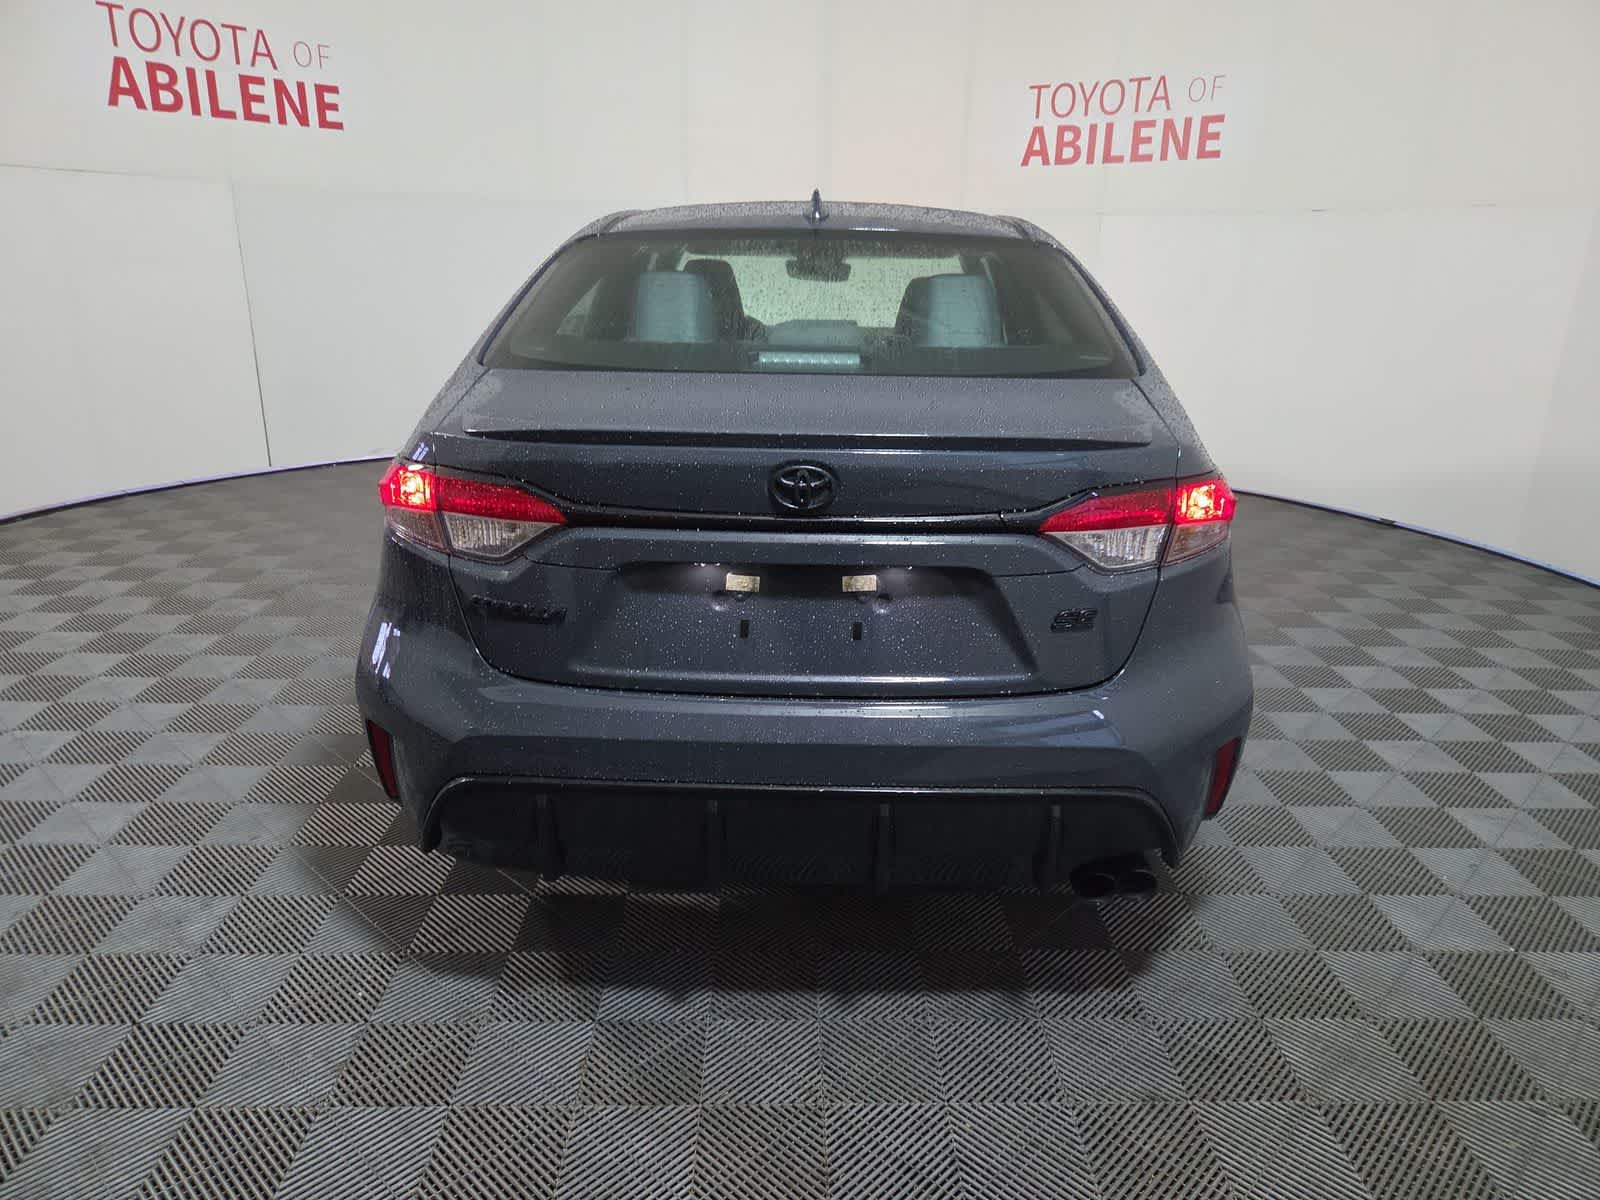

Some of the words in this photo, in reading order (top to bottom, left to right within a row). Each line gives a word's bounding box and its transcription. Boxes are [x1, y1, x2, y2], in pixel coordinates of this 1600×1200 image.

[95, 0, 278, 70] TOYOTA
[293, 41, 331, 69] OF
[107, 55, 344, 130] ABILENE
[1028, 75, 1171, 119] TOYOTA
[1188, 74, 1226, 103] OF
[1020, 114, 1226, 167] ABILENE
